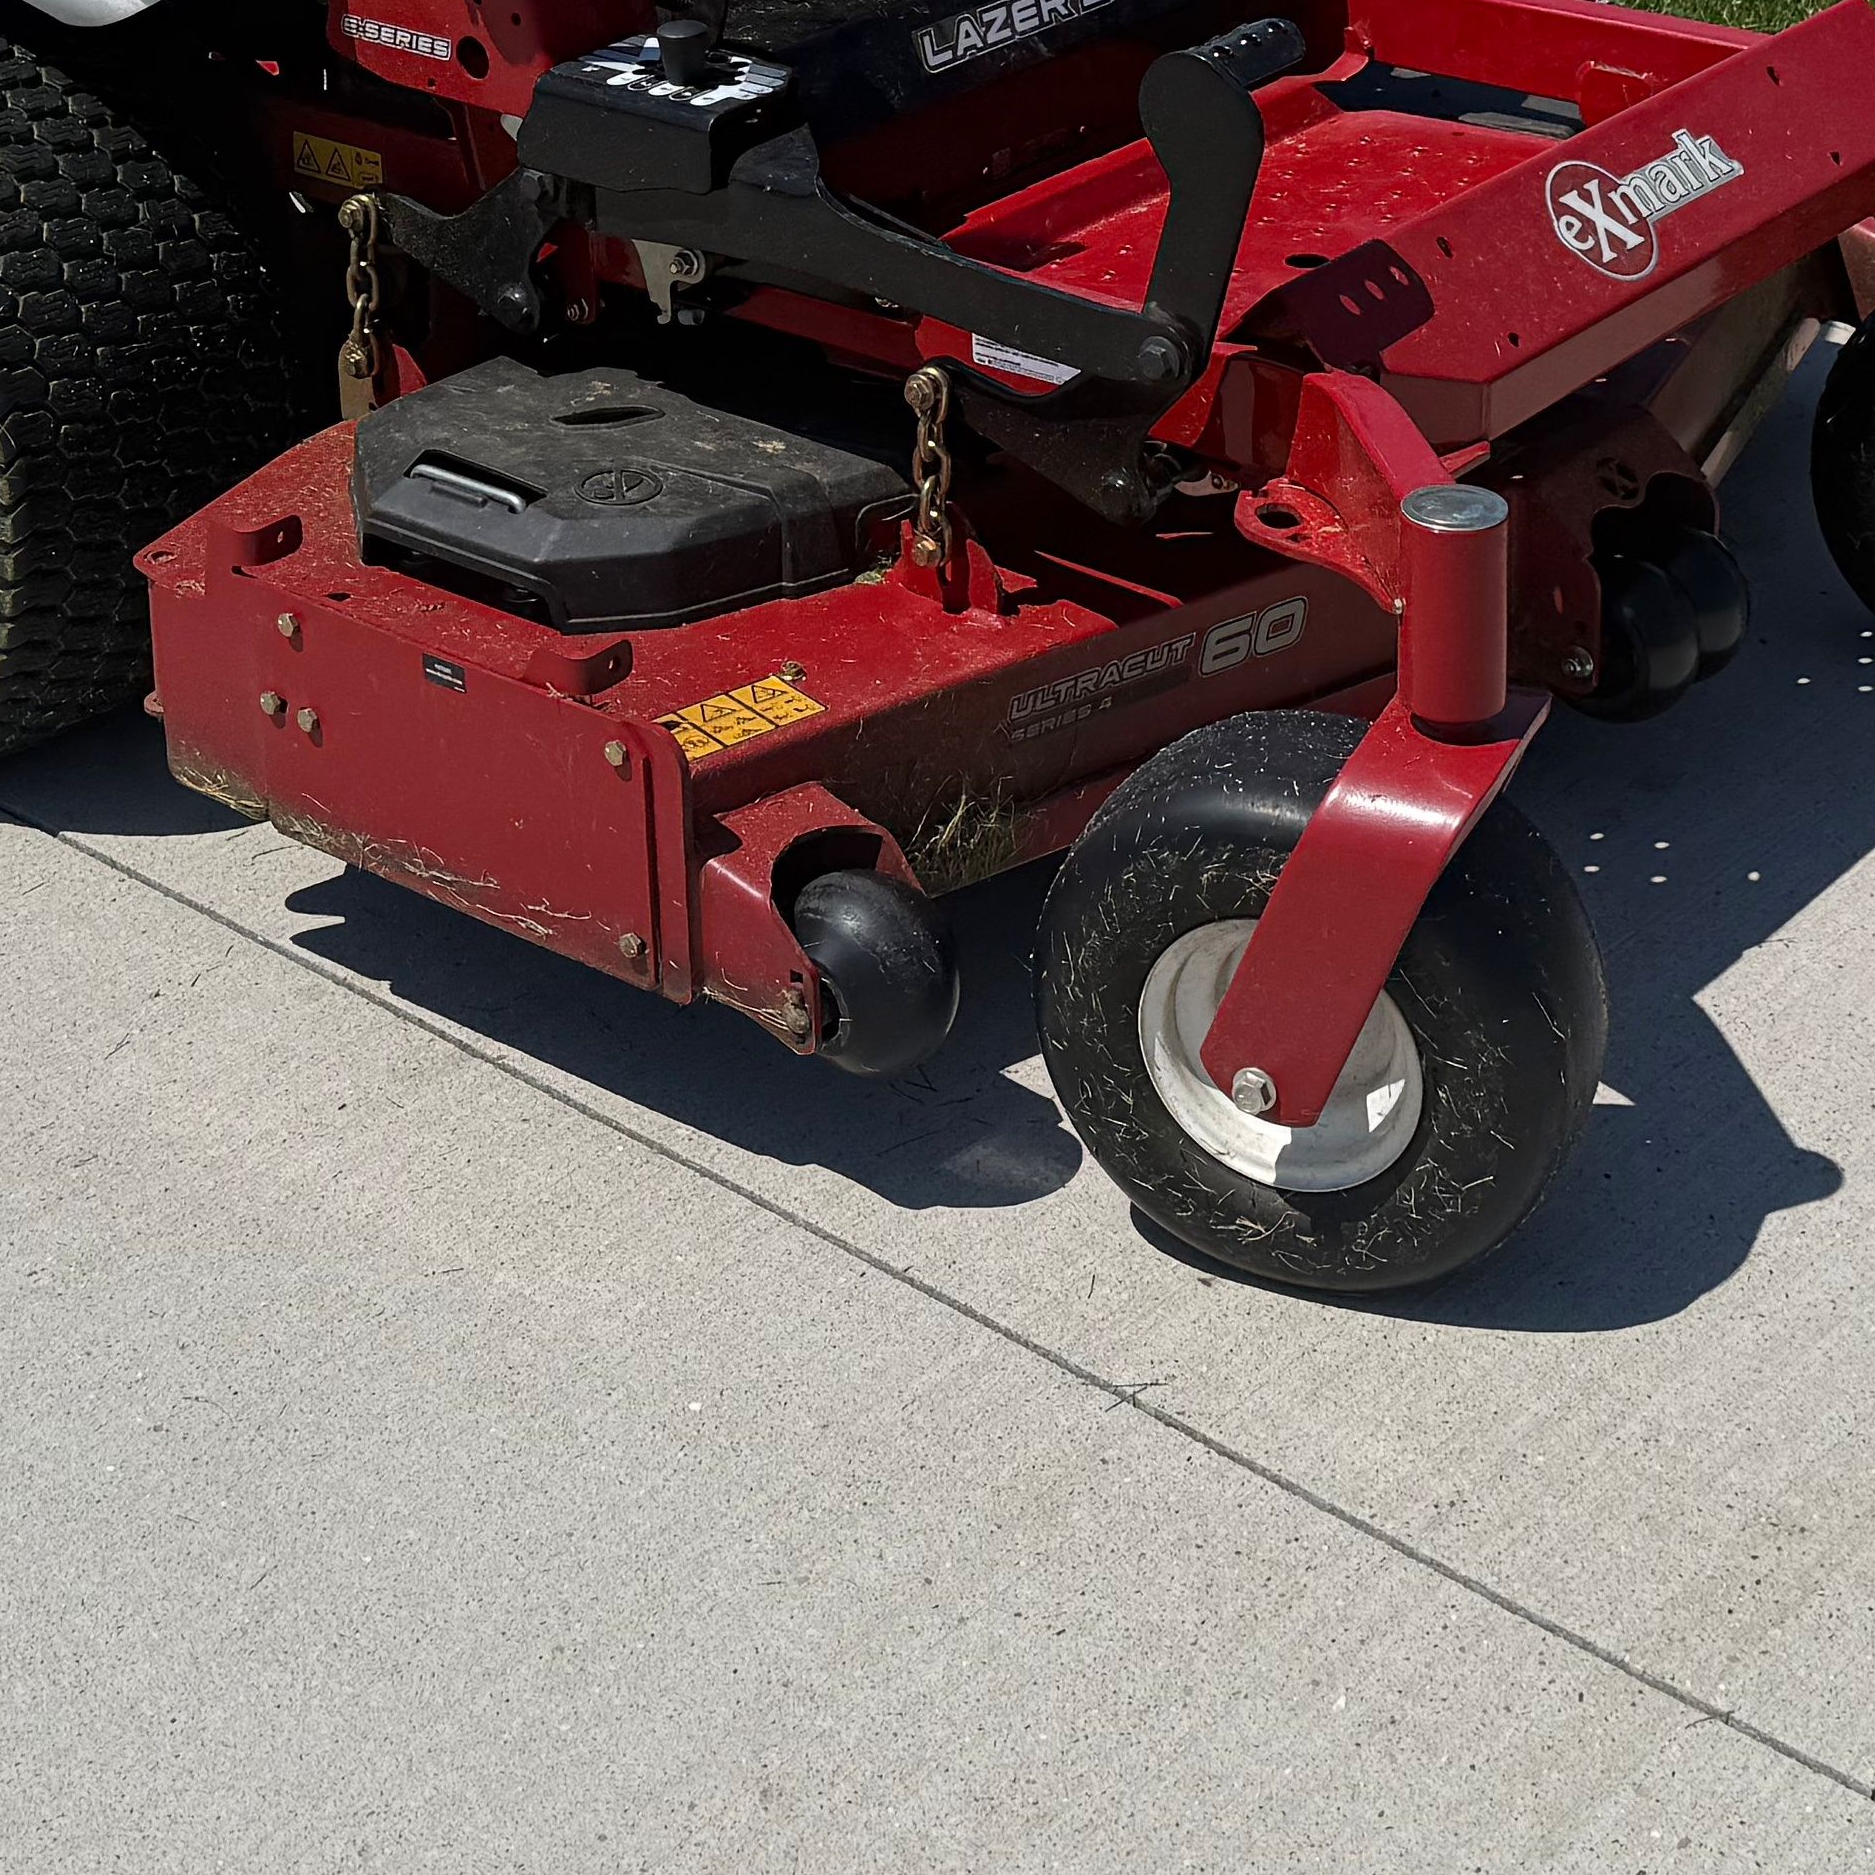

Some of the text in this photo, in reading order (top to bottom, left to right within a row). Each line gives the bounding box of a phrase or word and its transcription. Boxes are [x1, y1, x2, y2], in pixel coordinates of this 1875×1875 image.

[344, 17, 449, 58] E-SERIES
[1558, 131, 1733, 263] eXmark
[1009, 597, 1307, 721] ULTRACUT 60
[1011, 703, 1092, 741] SERIES
